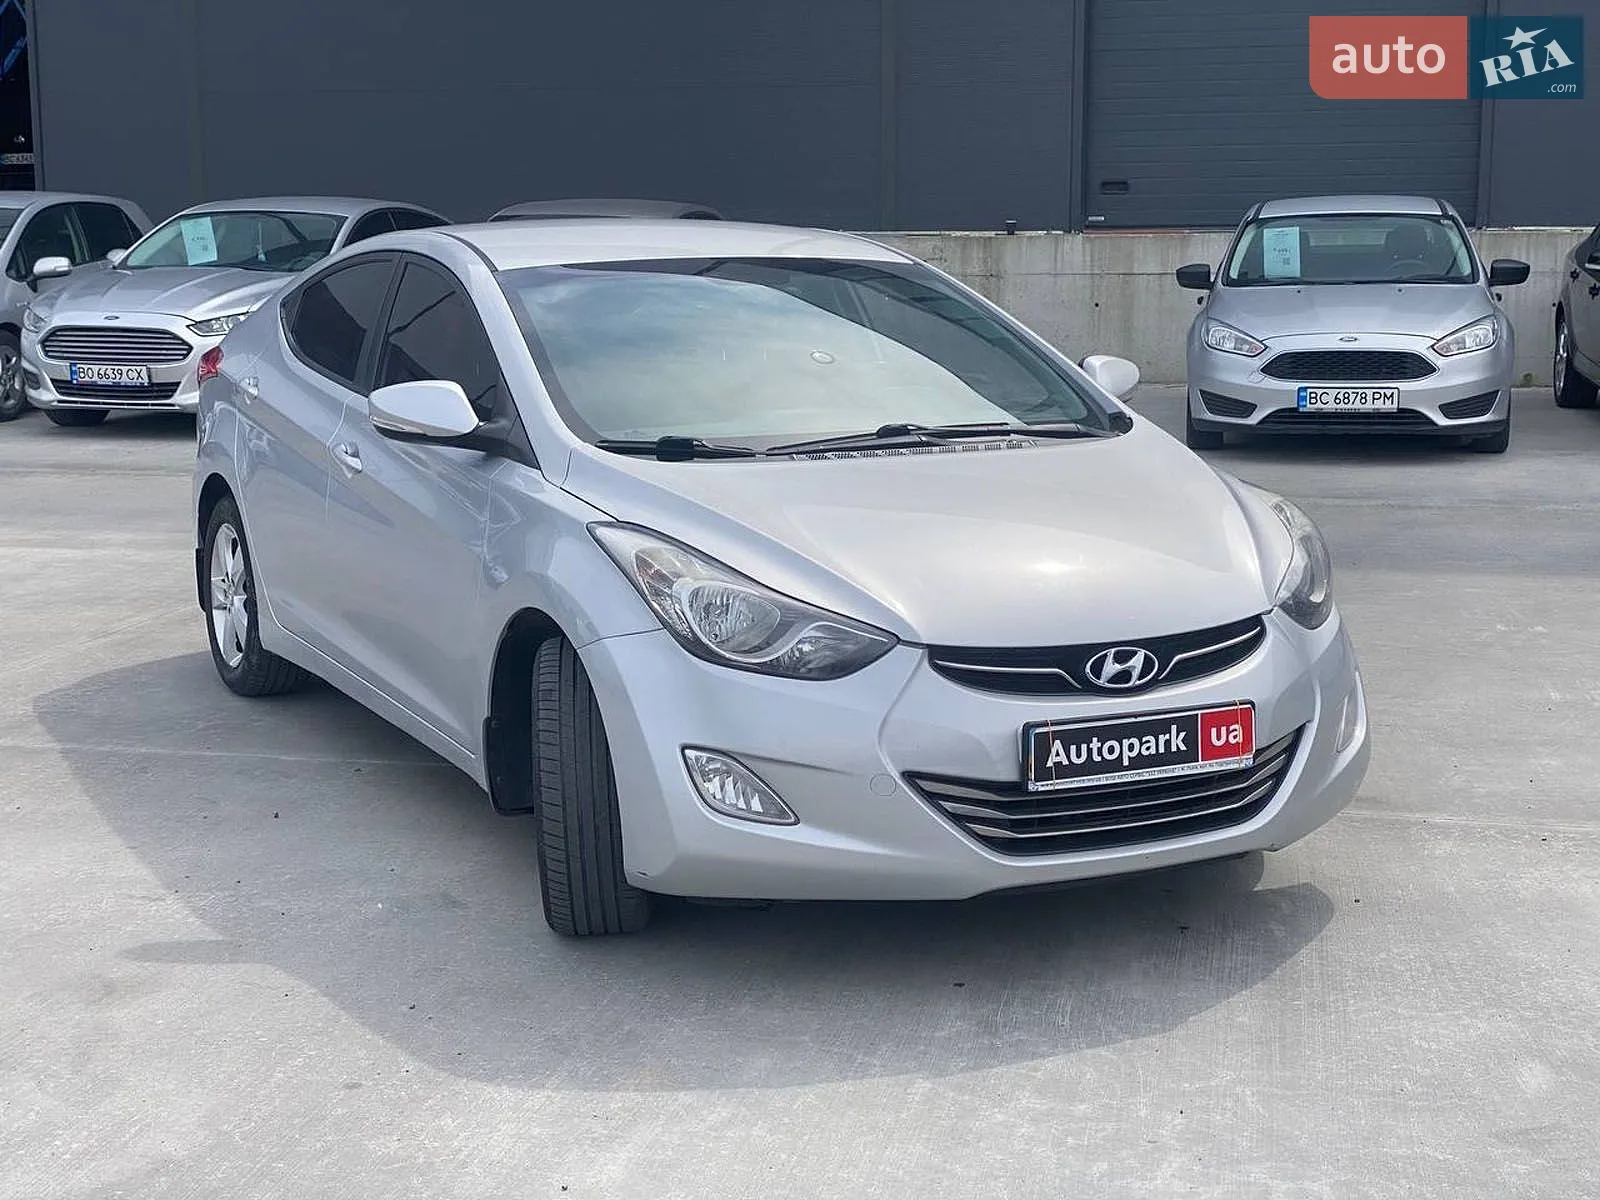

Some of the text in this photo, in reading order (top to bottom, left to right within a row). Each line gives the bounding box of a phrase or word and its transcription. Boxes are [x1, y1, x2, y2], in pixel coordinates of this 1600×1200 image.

[78, 366, 145, 381] BO 6639 CX
[1308, 391, 1395, 406] BC 6878 PM
[1045, 723, 1243, 768] Autopark ua
